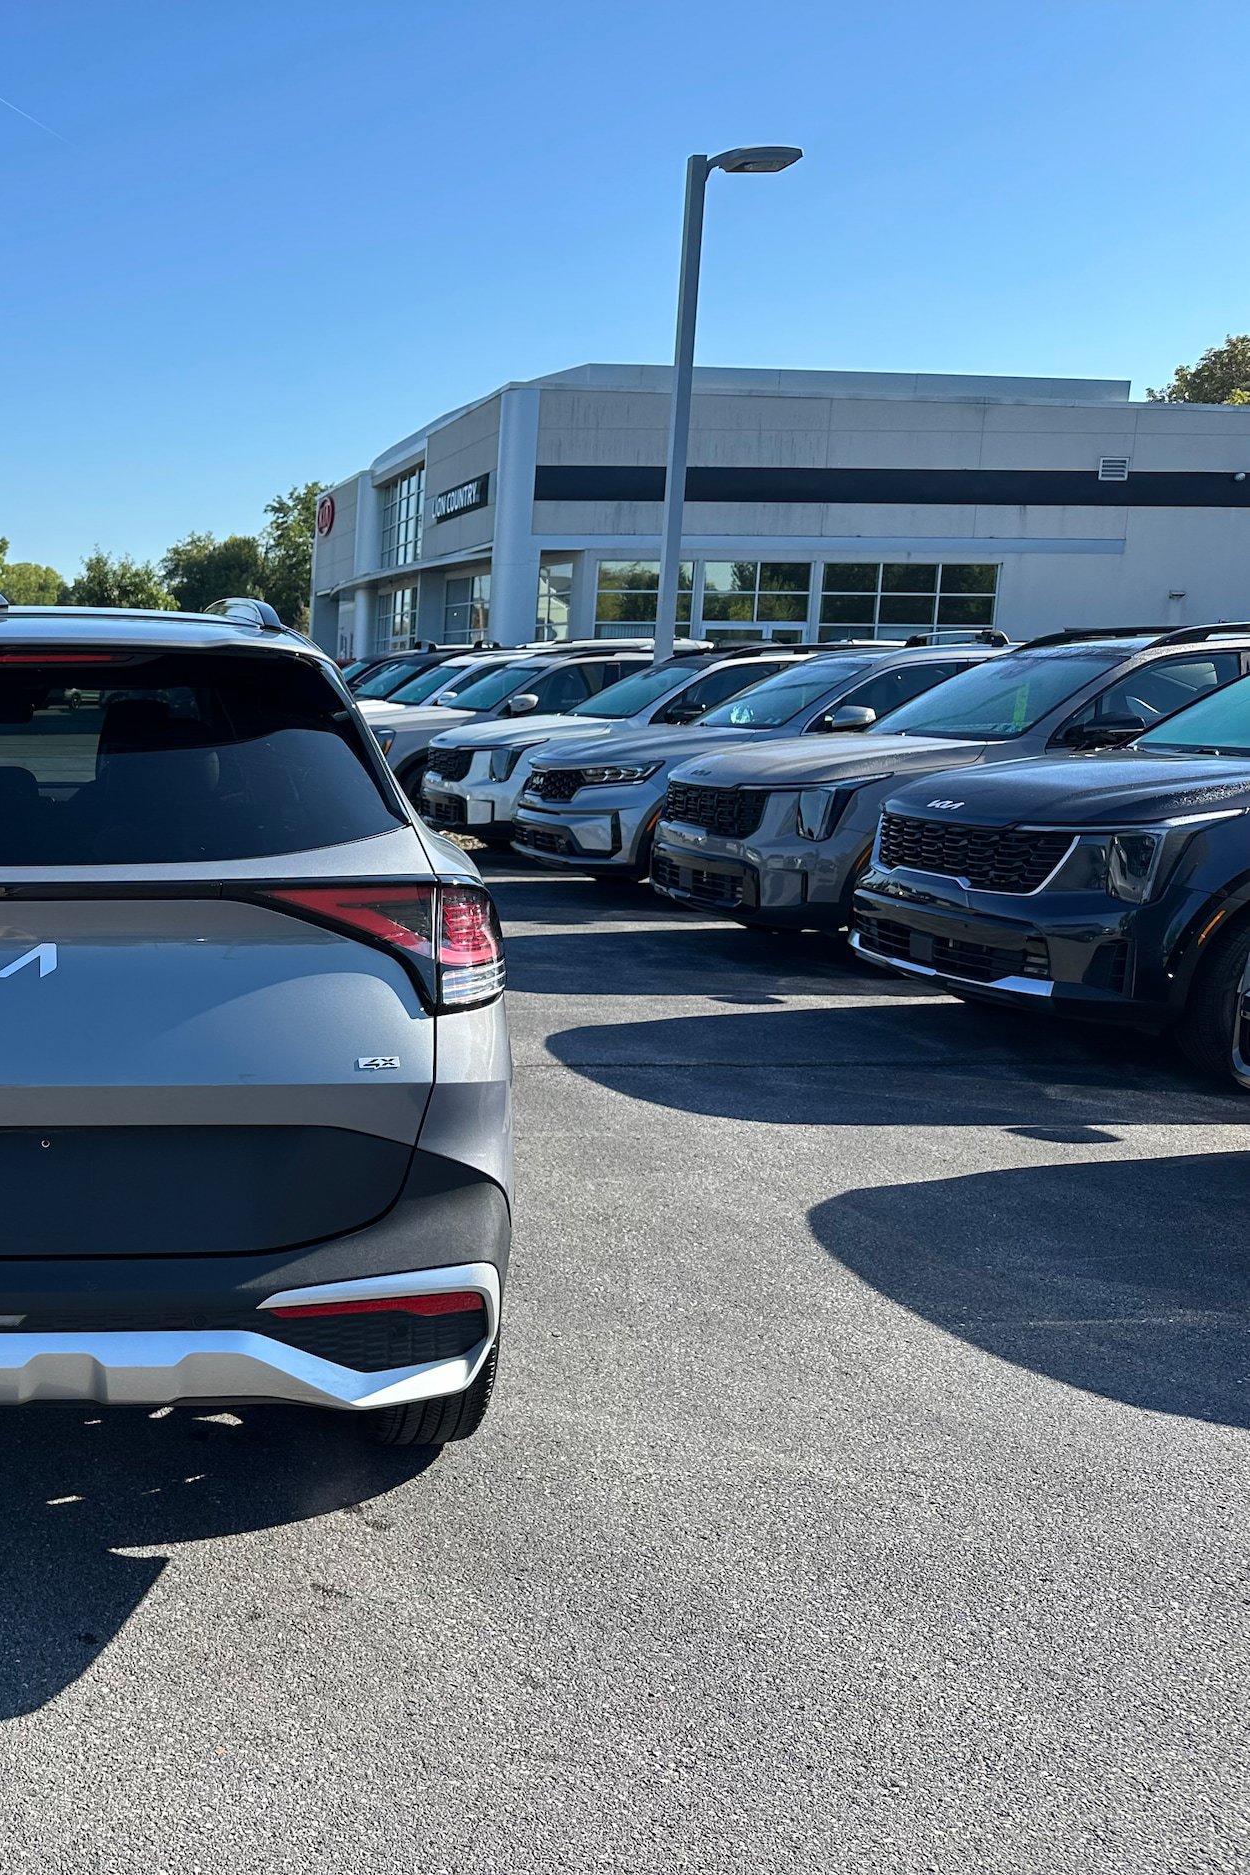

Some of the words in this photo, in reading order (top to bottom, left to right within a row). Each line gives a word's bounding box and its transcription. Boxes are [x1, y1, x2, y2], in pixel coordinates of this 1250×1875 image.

[432, 496, 447, 519] LION
[447, 481, 477, 513] COUNTRY
[926, 799, 965, 810] KIA
